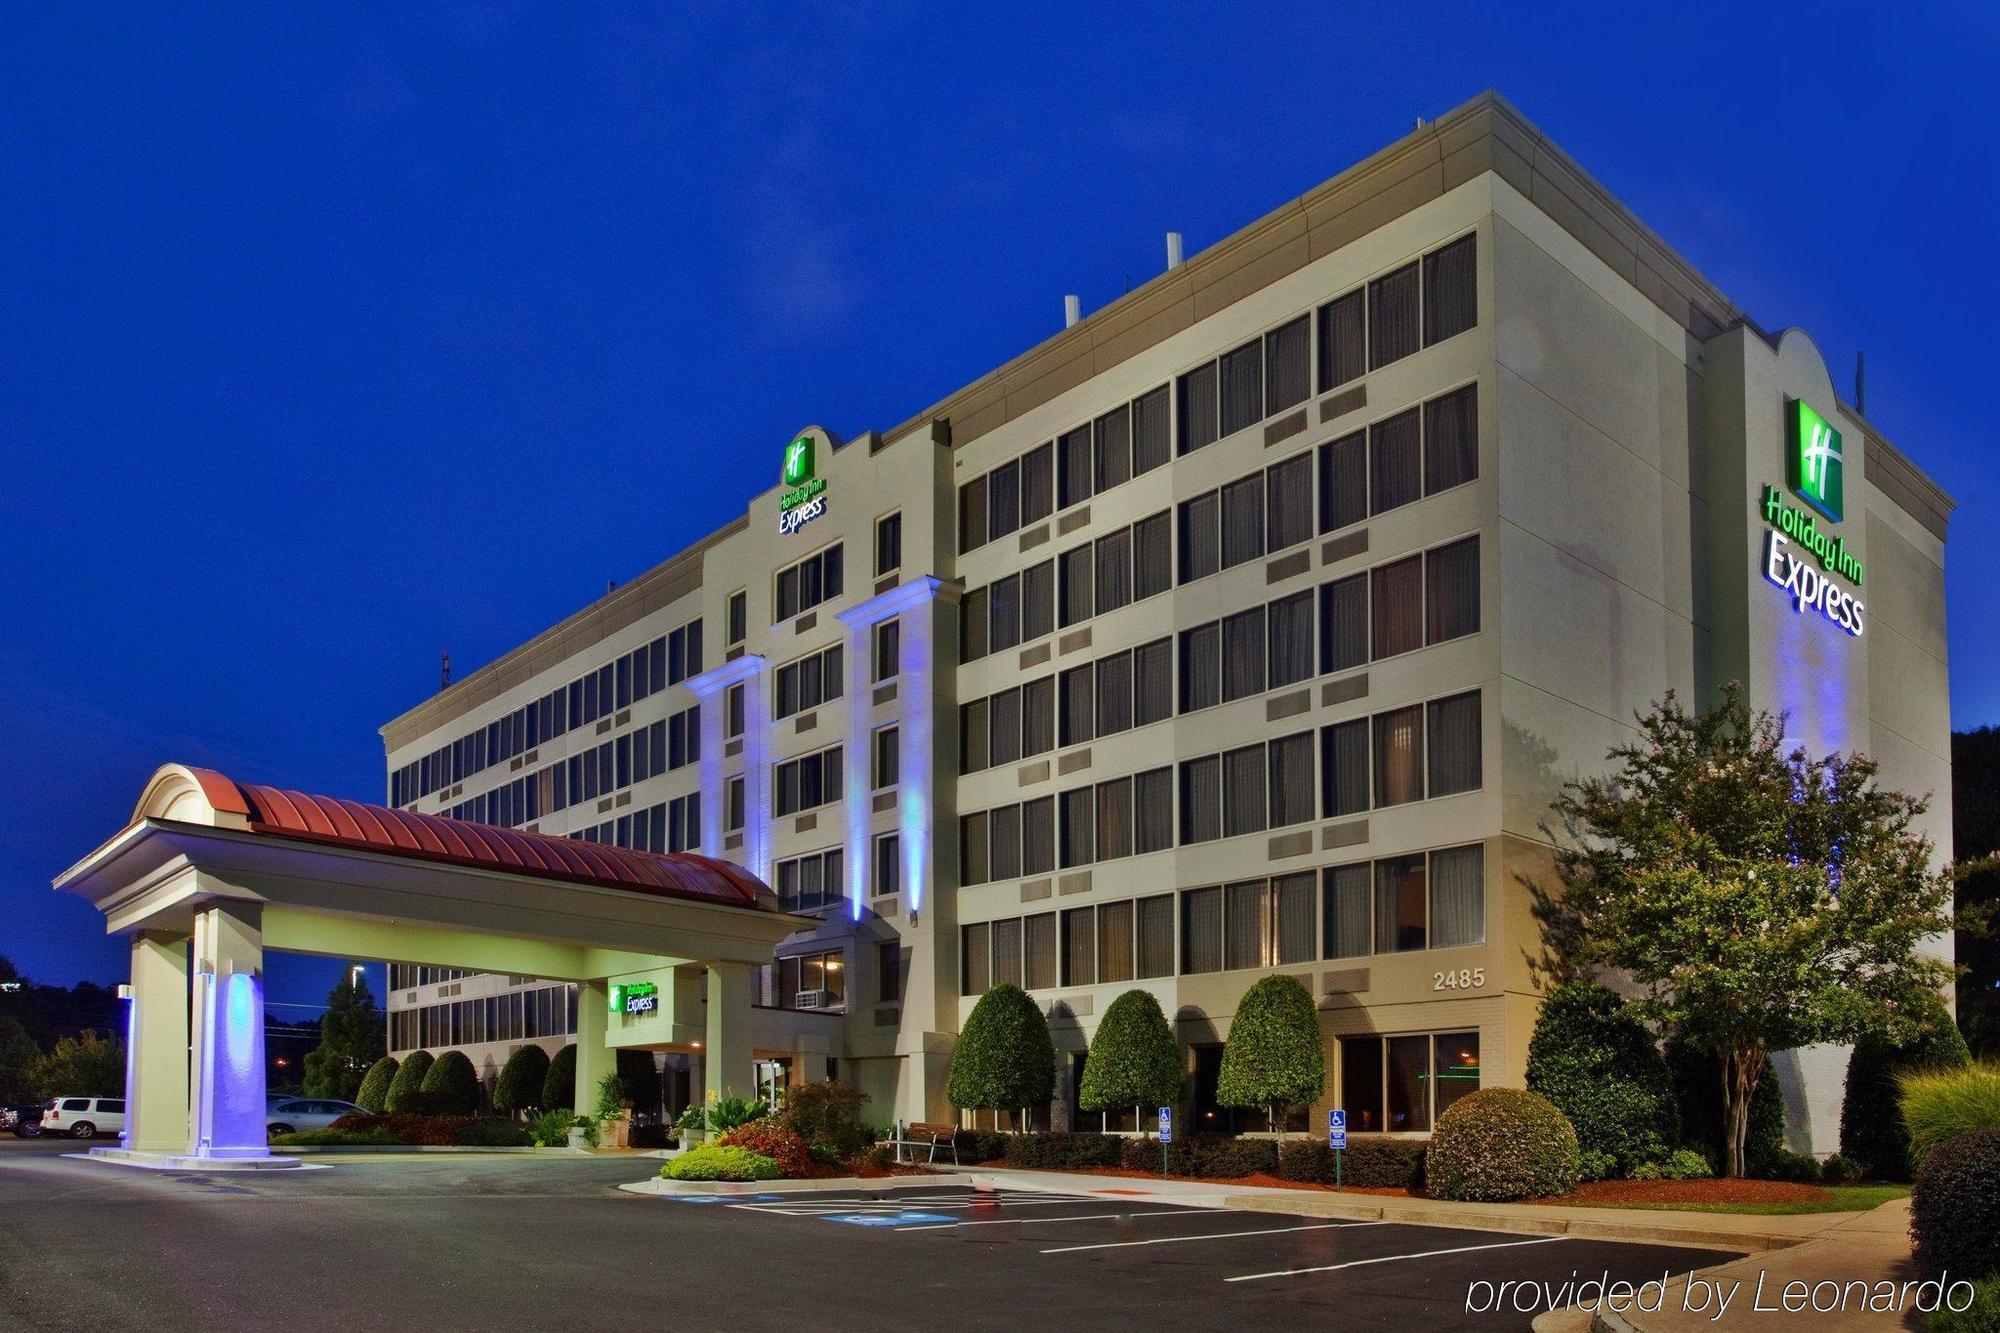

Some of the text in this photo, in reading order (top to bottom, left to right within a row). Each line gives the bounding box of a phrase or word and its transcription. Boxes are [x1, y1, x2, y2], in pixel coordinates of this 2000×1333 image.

[781, 486, 809, 510] Holiday
[780, 496, 823, 534] Express
[1766, 485, 1864, 585] Holiday Inn
[1767, 530, 1865, 637] Express
[1433, 967, 1486, 991] 2485
[627, 996, 653, 1014] Express
